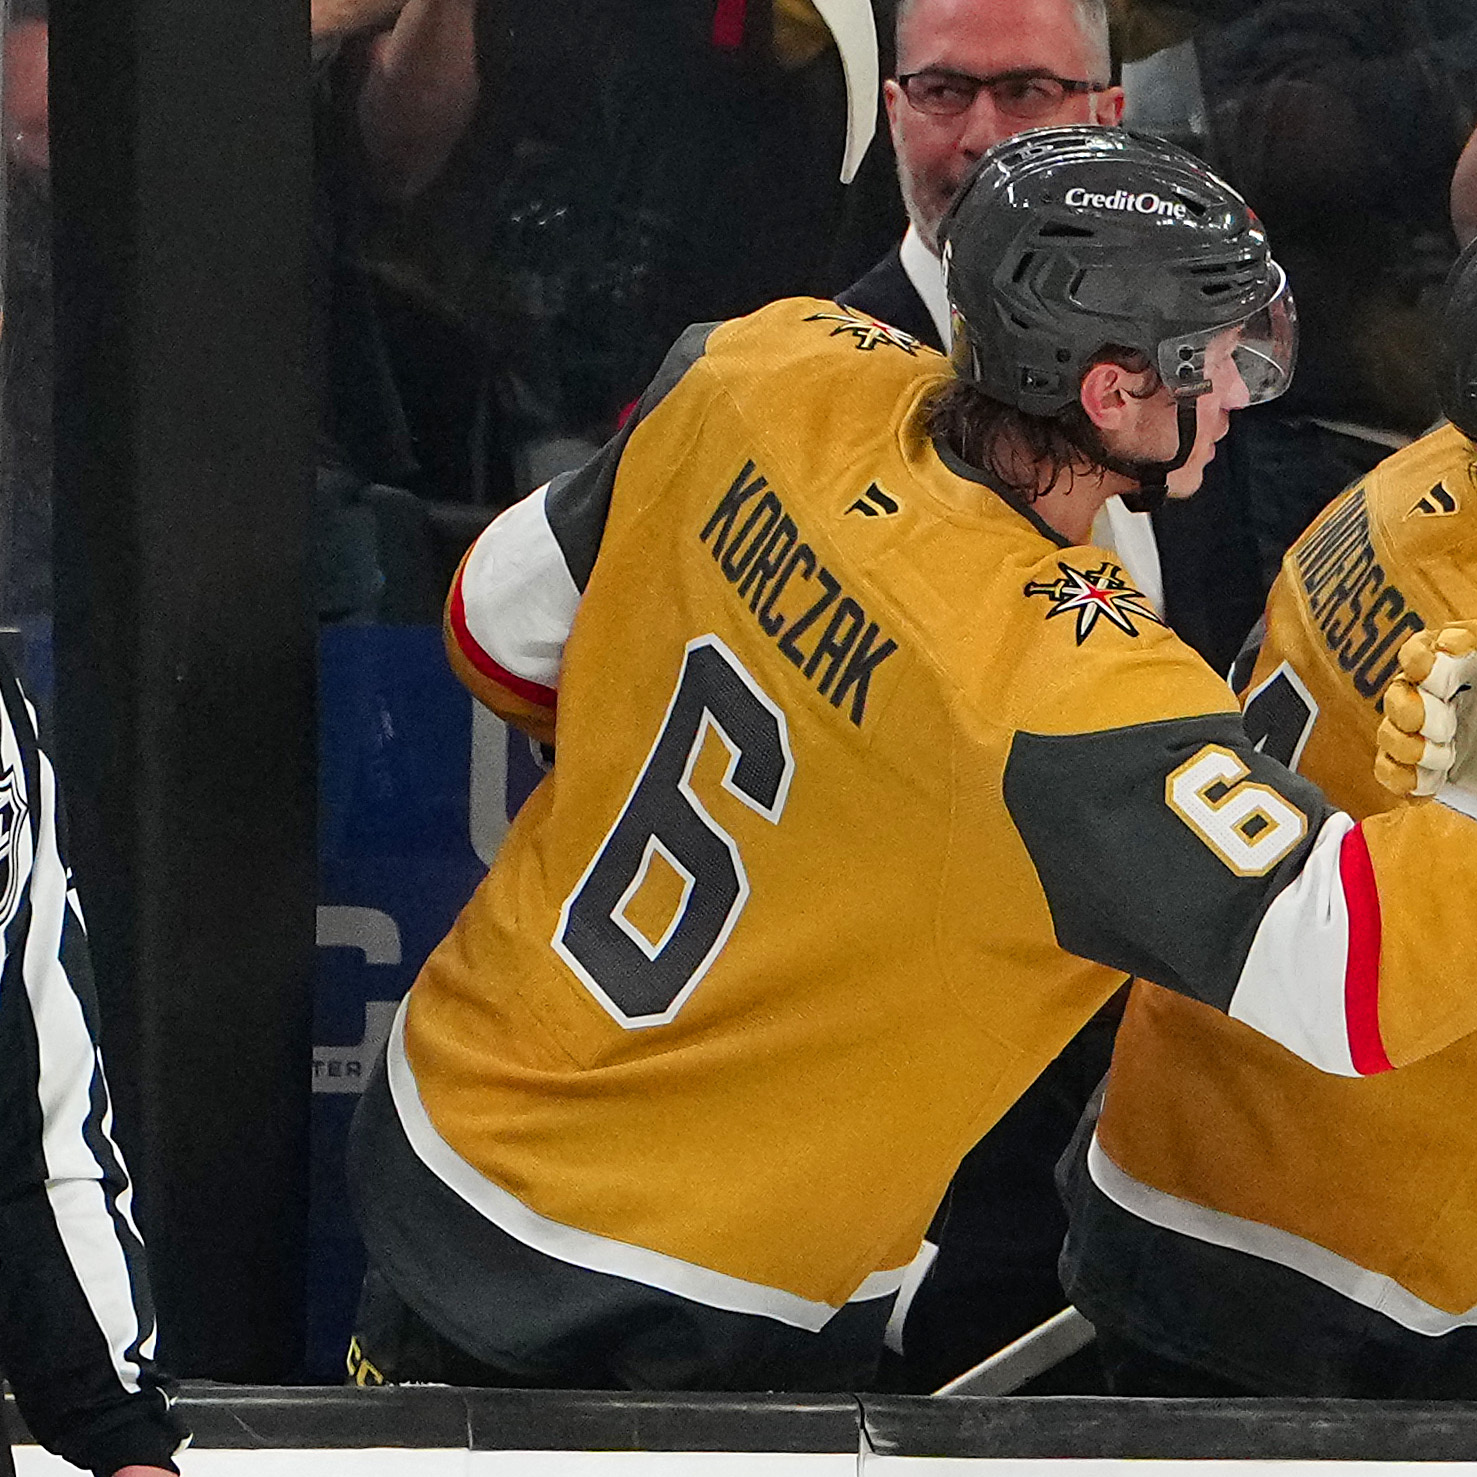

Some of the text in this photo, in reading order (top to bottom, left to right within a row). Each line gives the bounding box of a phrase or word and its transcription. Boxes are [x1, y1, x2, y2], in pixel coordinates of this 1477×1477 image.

[1065, 187, 1187, 218] CreditOne
[699, 458, 899, 728] KORCZAK
[550, 632, 797, 1031] 6
[1165, 742, 1309, 878] 6
